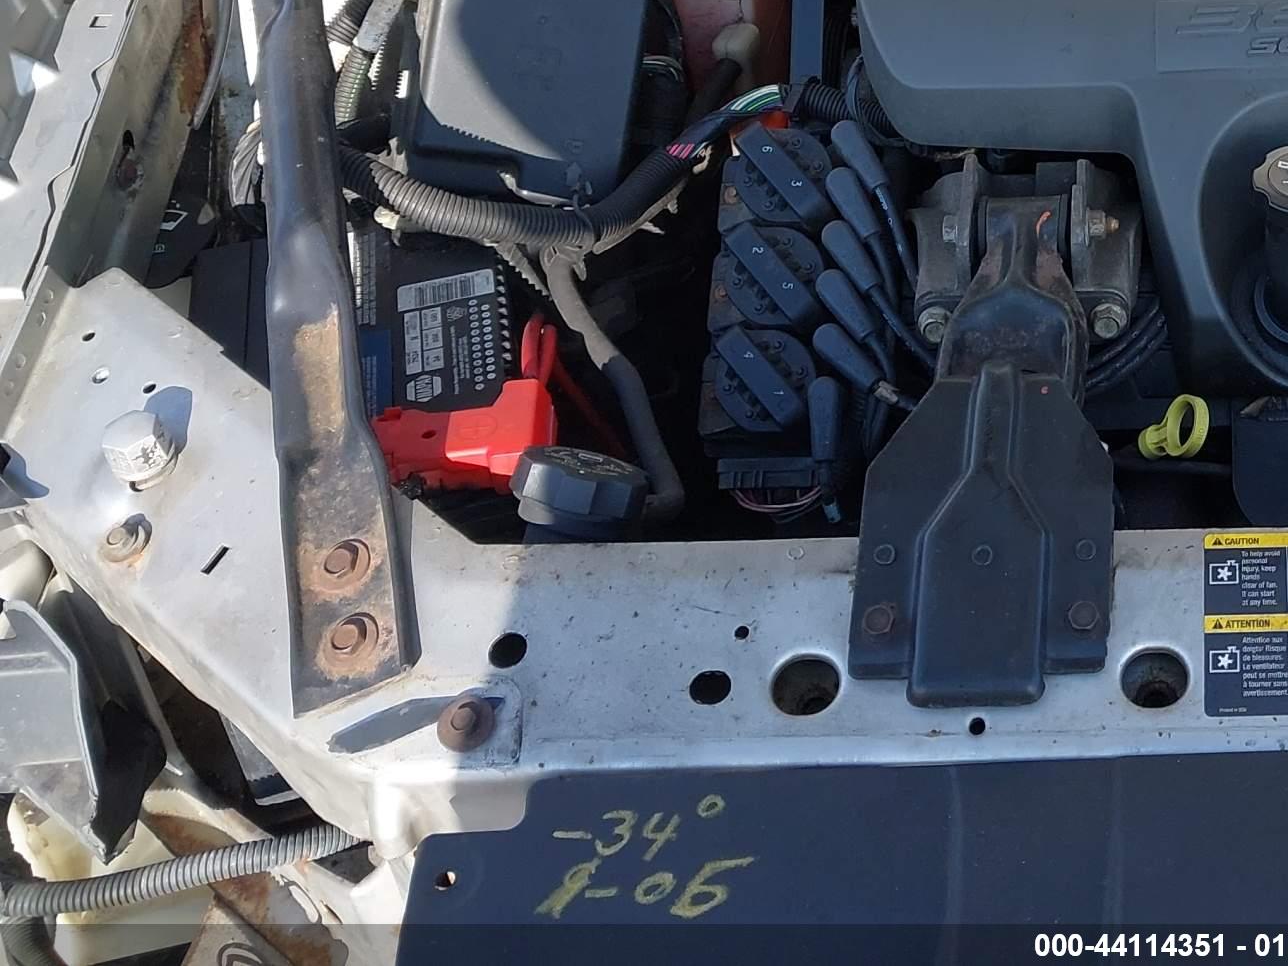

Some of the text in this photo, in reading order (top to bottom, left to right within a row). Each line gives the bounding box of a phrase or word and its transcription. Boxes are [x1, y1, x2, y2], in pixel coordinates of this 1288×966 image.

[761, 145, 773, 154] 6
[790, 179, 802, 188] 3
[751, 245, 764, 255] 2
[782, 281, 794, 290] 5
[414, 376, 434, 399] NAPA
[1226, 620, 1270, 628] ATTENTION
